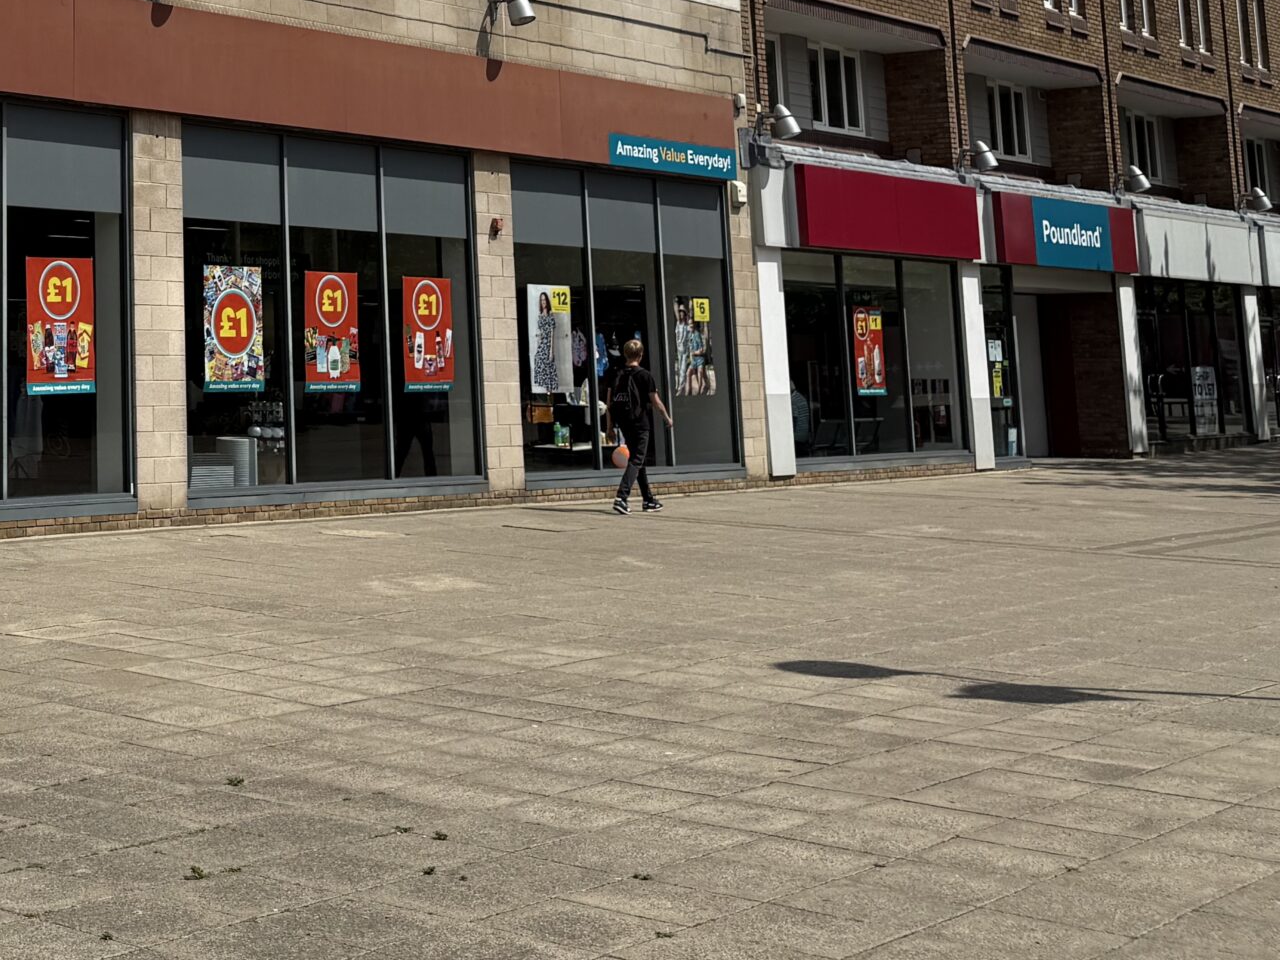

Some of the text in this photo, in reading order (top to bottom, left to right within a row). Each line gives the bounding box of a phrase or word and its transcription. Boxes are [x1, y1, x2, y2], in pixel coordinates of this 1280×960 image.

[616, 140, 732, 172] Amazing Value Everyday!
[46, 276, 72, 302] £1
[322, 289, 342, 312] £1
[418, 293, 437, 315] £1
[220, 307, 247, 337] £1
